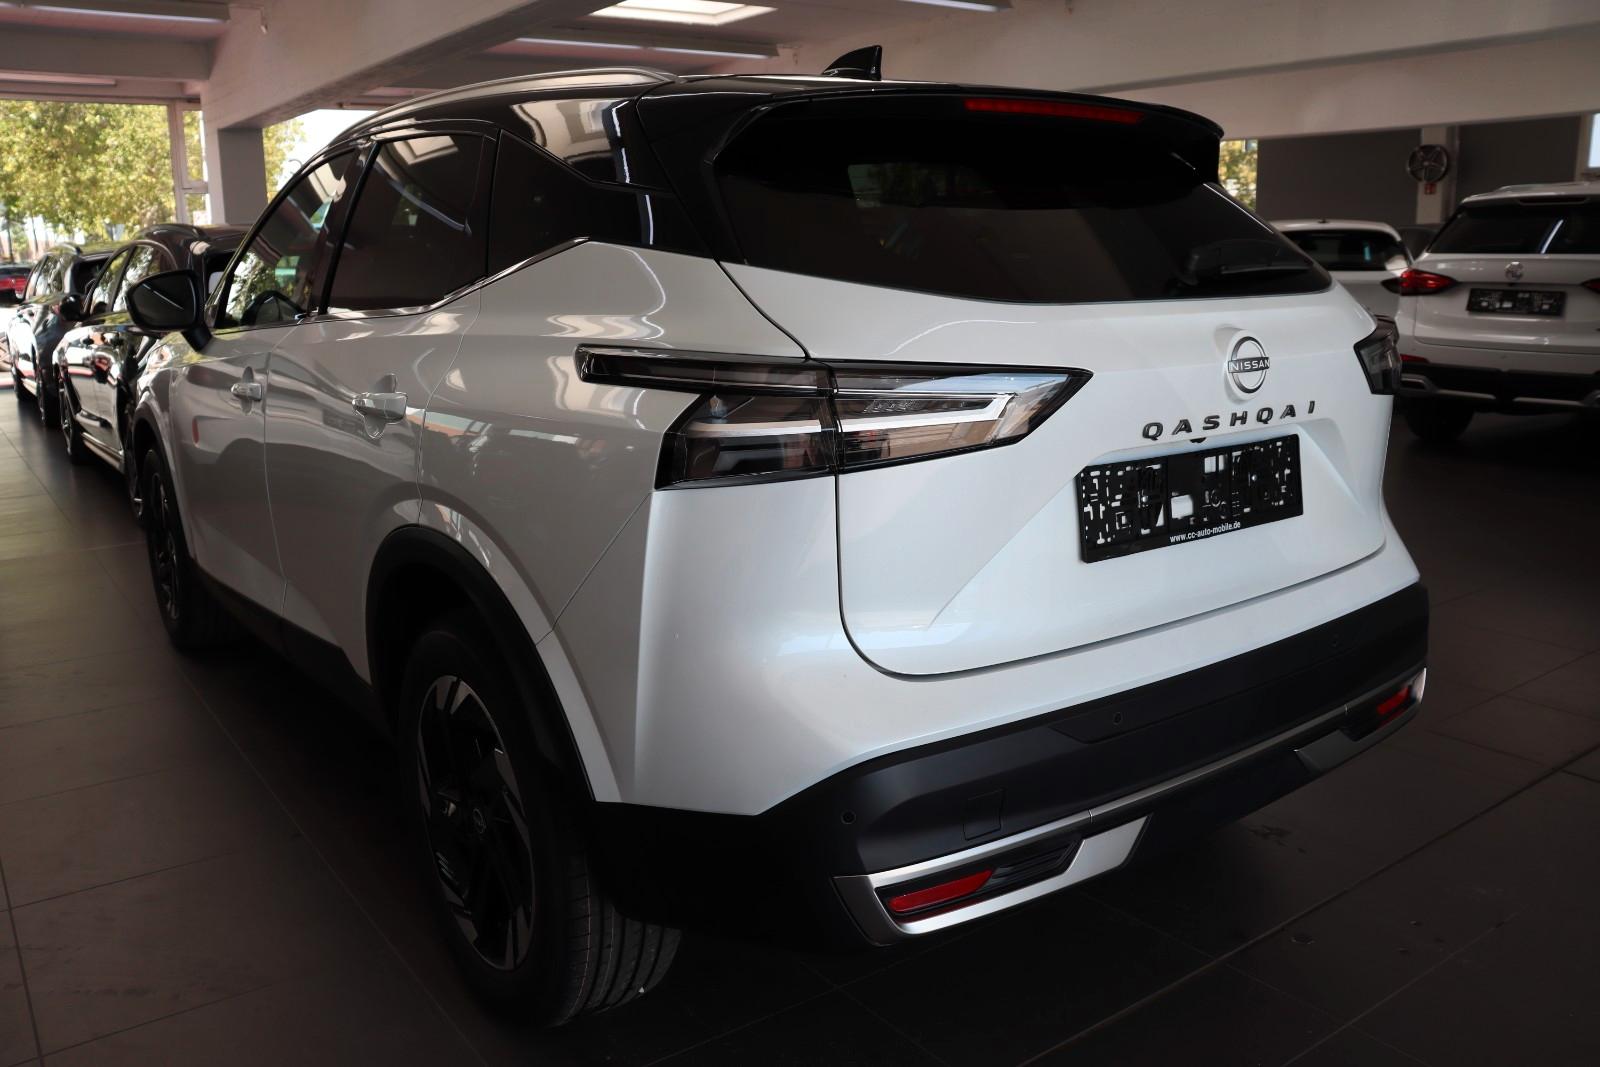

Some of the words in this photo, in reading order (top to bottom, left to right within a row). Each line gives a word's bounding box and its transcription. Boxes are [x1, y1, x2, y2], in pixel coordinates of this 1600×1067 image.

[1229, 358, 1270, 372] NISSAN
[1142, 400, 1315, 441] QASHQAI
[1169, 521, 1241, 543] www.cc-auto-mobile.de
